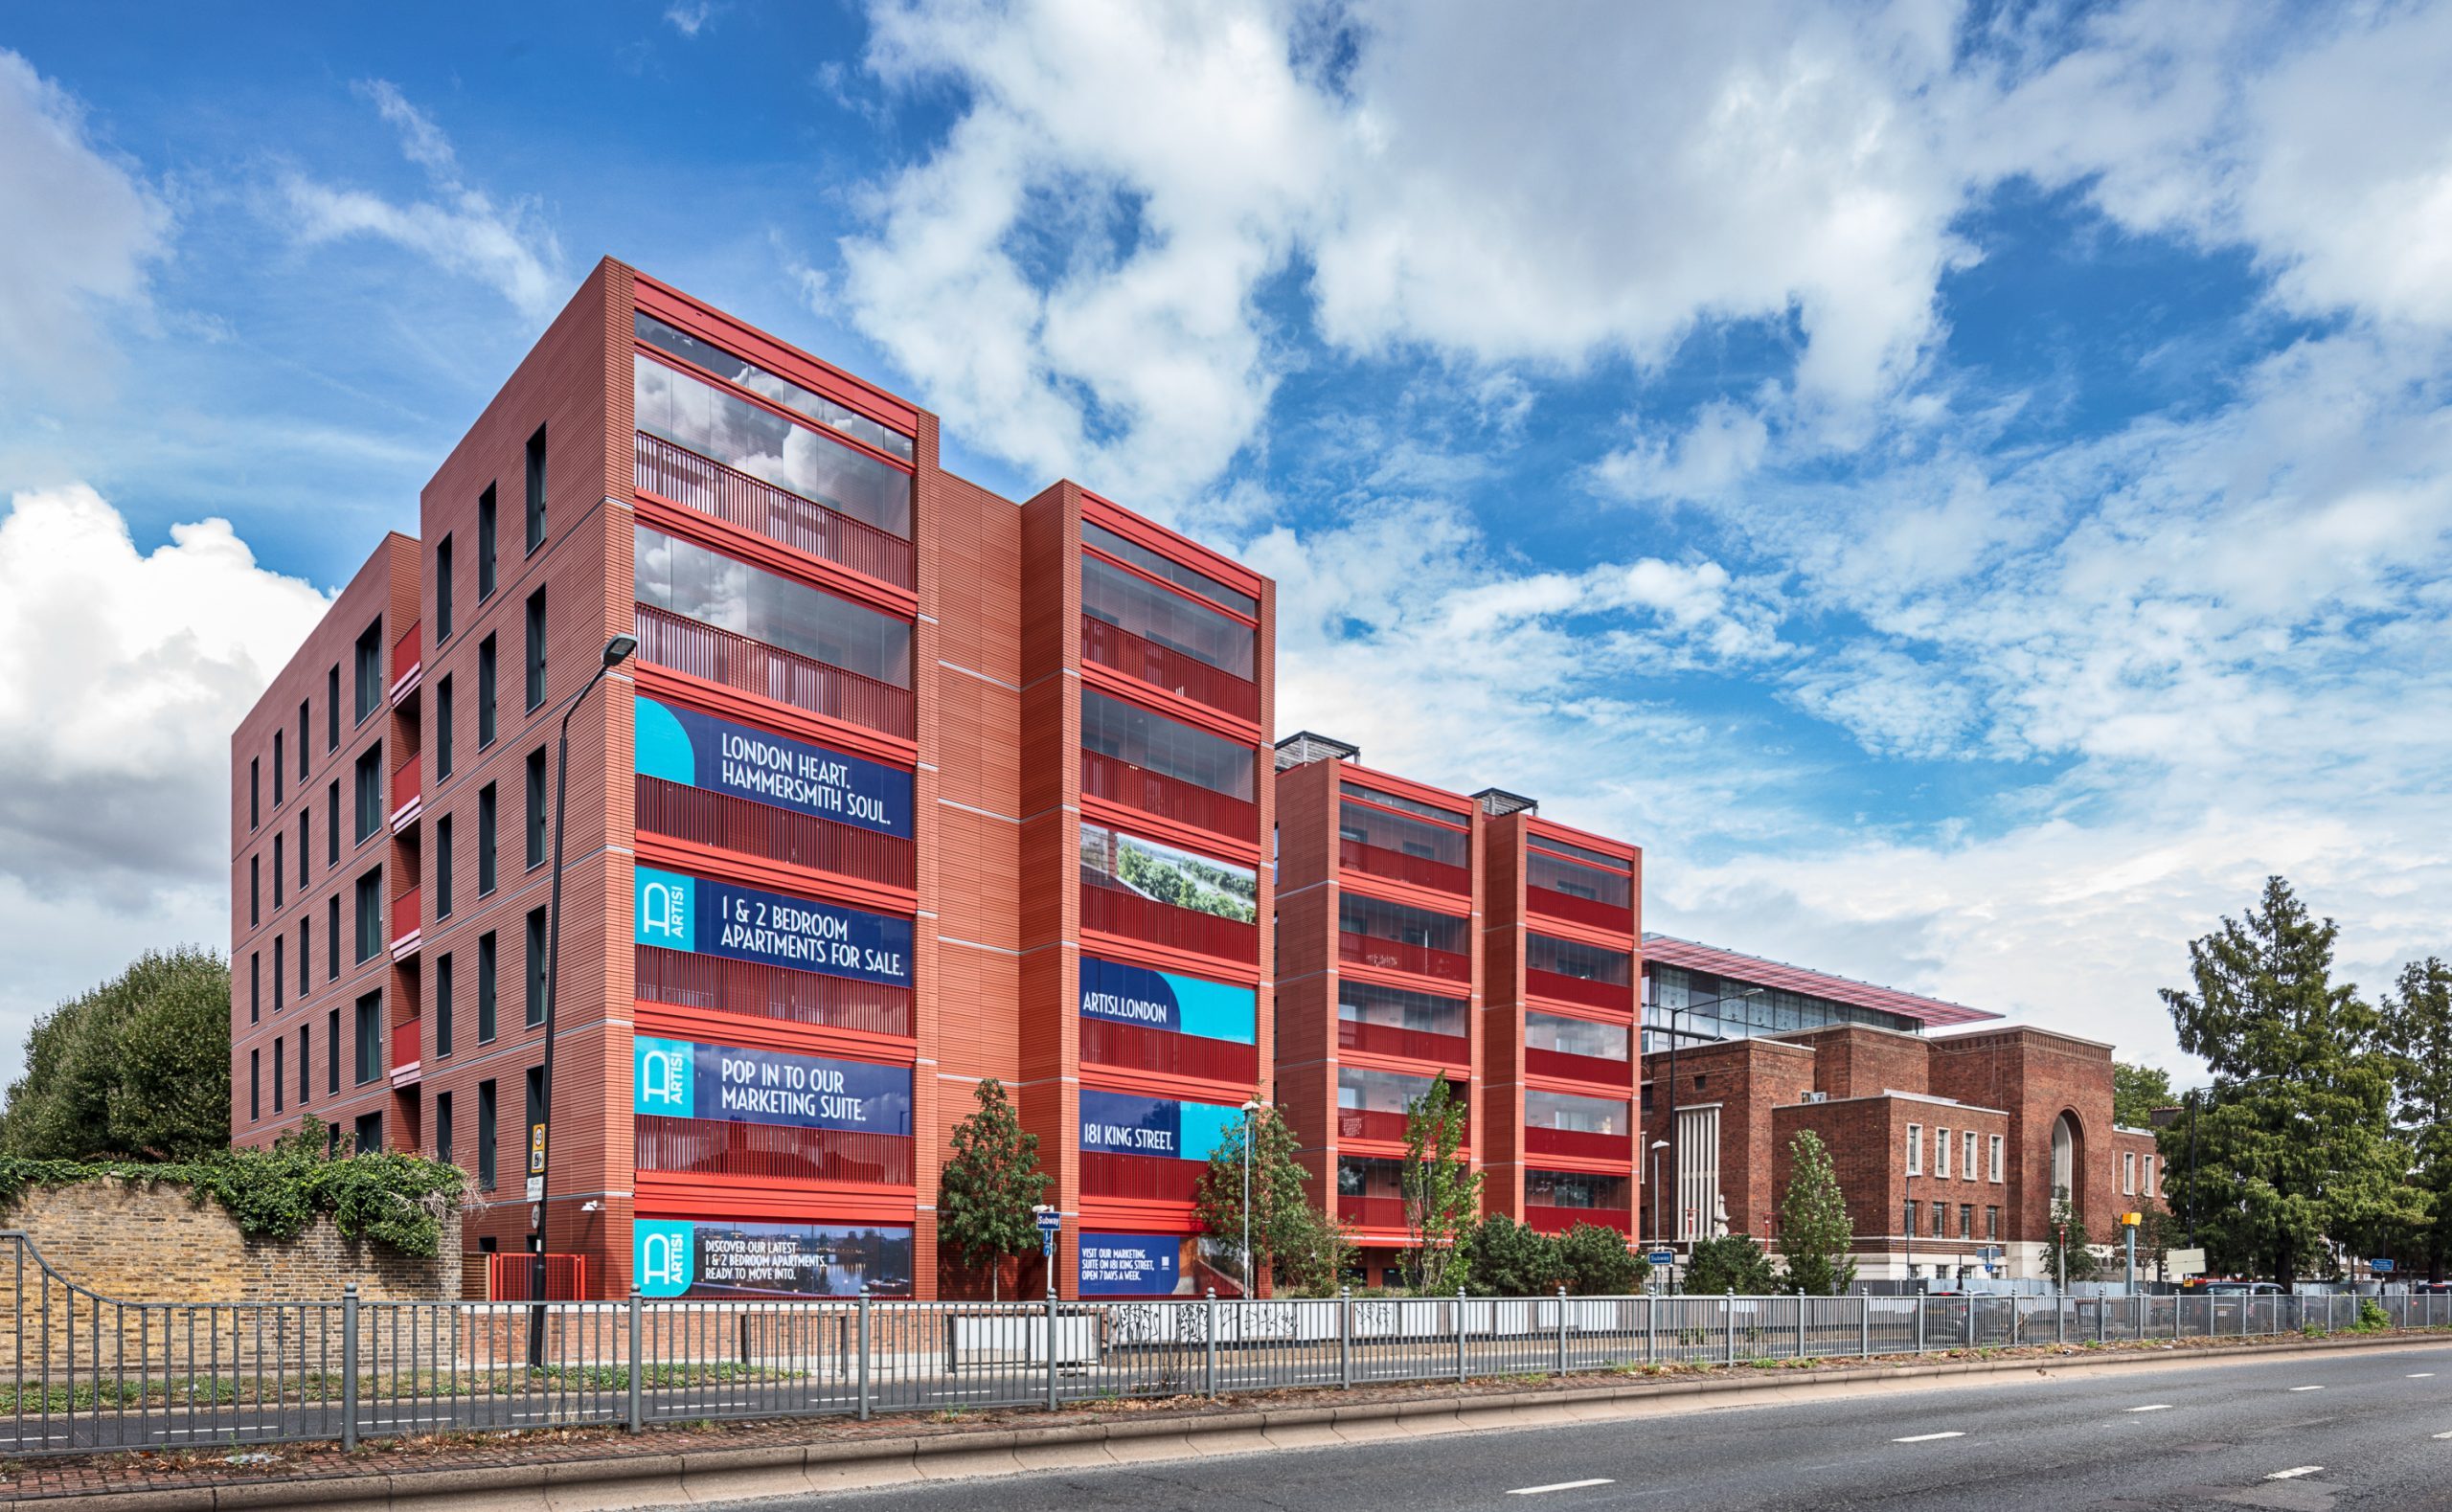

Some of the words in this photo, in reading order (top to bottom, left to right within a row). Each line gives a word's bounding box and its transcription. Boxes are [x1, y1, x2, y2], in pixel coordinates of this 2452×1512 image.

[723, 733, 792, 770] LONDON
[799, 756, 851, 789] HEART.
[723, 761, 841, 812] HAMMERSMITH
[847, 794, 890, 824] SOUL.
[671, 887, 684, 938] ARTISI
[736, 899, 750, 922] &
[756, 903, 766, 926] 2
[774, 906, 847, 941] BEDROOM
[721, 925, 825, 962] APARTMENTS
[832, 946, 859, 968] FOR
[865, 949, 904, 976] SALE.
[1083, 992, 1167, 1024] ARTISI.LONDON
[671, 1053, 682, 1104] ARTISI
[723, 1059, 754, 1083] POP
[763, 1063, 778, 1086] IN
[785, 1066, 805, 1089] TO
[811, 1069, 844, 1093] OUR
[722, 1086, 814, 1116] MARKETING
[821, 1096, 866, 1121] SUITE.
[1085, 1123, 1101, 1144] 181
[1105, 1126, 1131, 1147] KING
[1135, 1129, 1173, 1150] STREET.
[1039, 1216, 1059, 1226] Subway
[671, 1234, 683, 1284] ARTISI
[706, 1240, 745, 1252] DISCOVER
[748, 1242, 765, 1253] OUR
[768, 1242, 796, 1254] LATEST
[712, 1255, 719, 1266] &
[721, 1255, 726, 1266] 2
[729, 1255, 770, 1266] BEDROOM
[772, 1255, 827, 1267] APARTMENTS.
[1082, 1248, 1097, 1257] VISIT
[1099, 1249, 1111, 1258] OUR
[1113, 1249, 1145, 1259] MARKETING
[706, 1268, 733, 1279] READY
[735, 1268, 745, 1279] TO
[749, 1268, 772, 1280] MOVE
[775, 1268, 796, 1280] INTO.
[1082, 1259, 1098, 1269] SUITE
[1100, 1260, 1109, 1269] ON
[1119, 1260, 1133, 1270] KING
[1134, 1261, 1154, 1271] STREET,
[1082, 1271, 1098, 1280] OPEN
[1099, 1271, 1103, 1280] 7
[1104, 1271, 1118, 1280] DAYS
[1119, 1271, 1123, 1280] A
[1124, 1271, 1141, 1280] WEEK.
